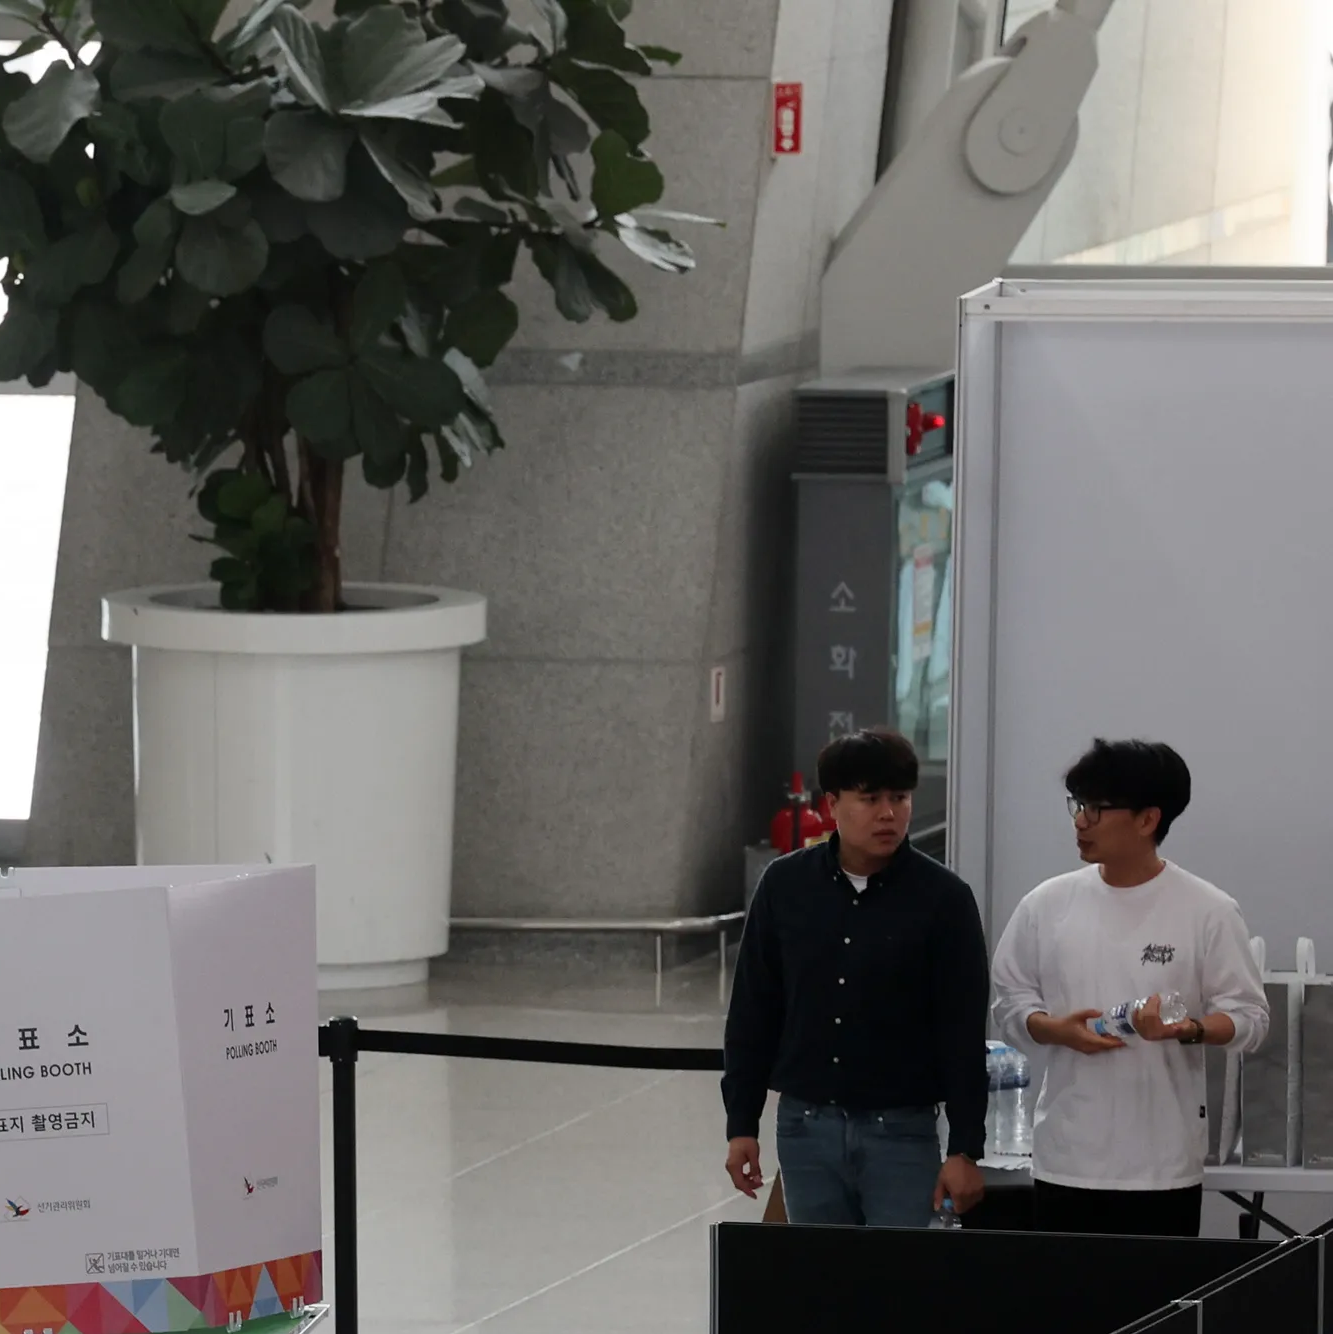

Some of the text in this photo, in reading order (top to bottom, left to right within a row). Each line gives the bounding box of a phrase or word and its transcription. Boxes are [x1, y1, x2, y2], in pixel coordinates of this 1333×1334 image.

[226, 1039, 277, 1059] POLLING BOOTH
[40, 1062, 92, 1078] BOOTH
[31, 1110, 95, 1132] 촬영금지
